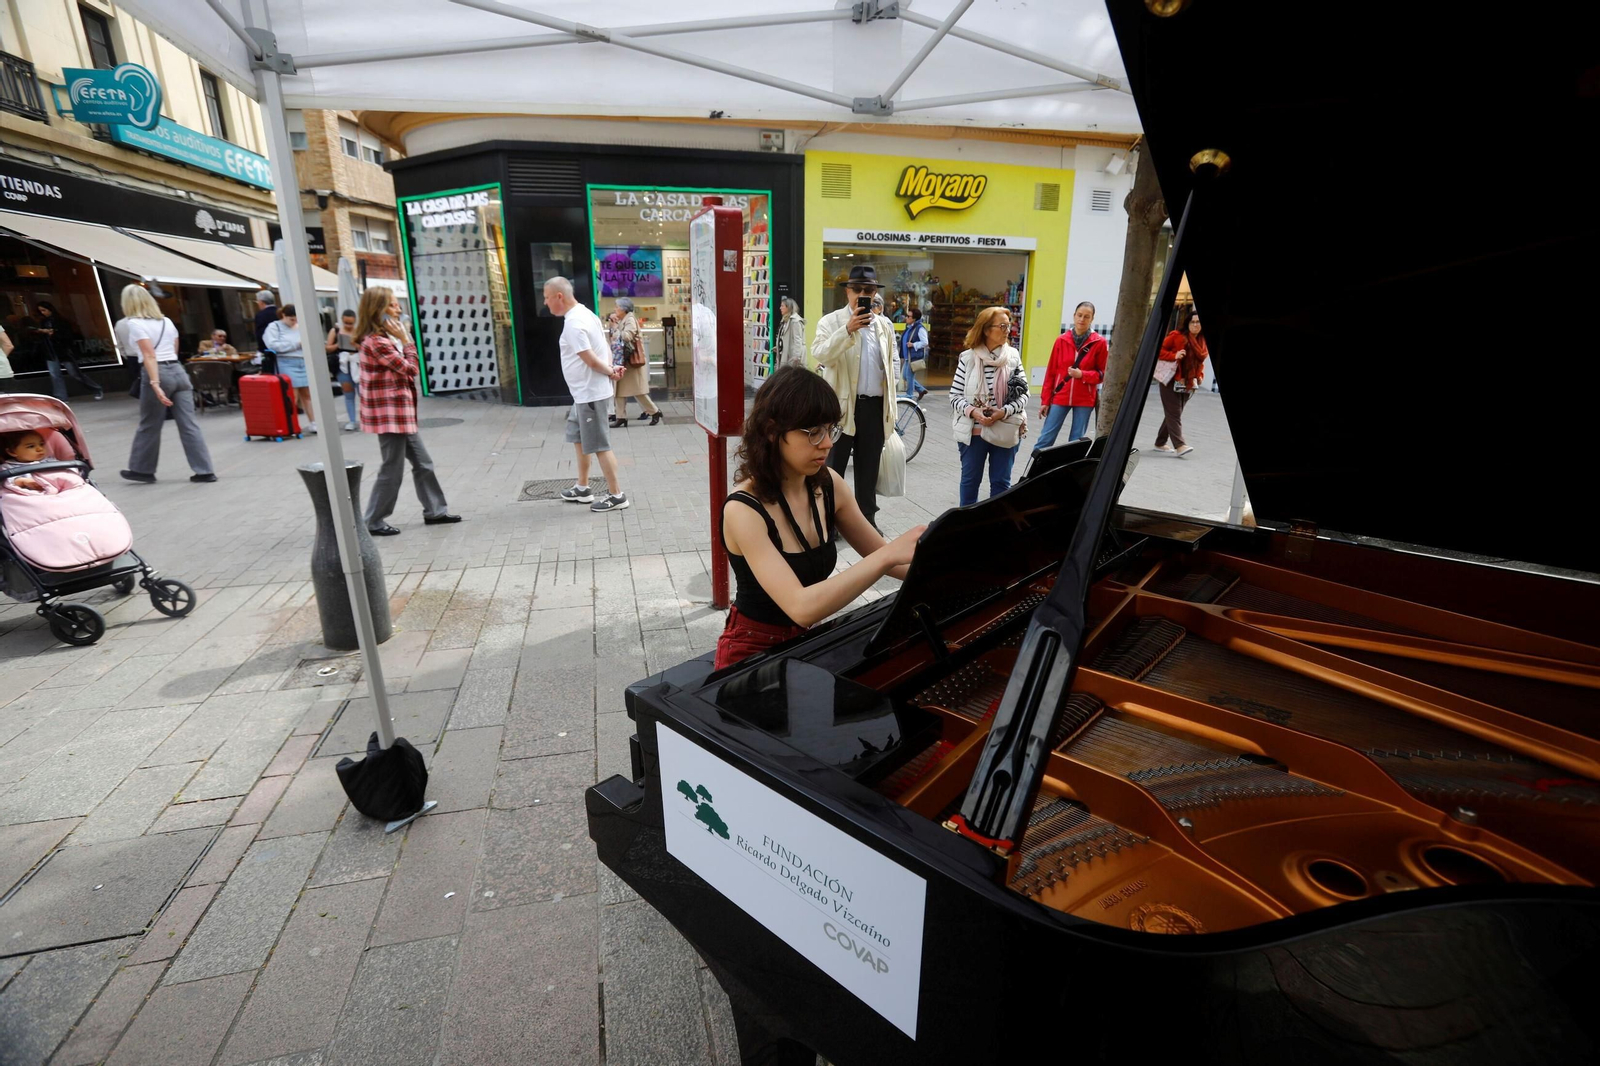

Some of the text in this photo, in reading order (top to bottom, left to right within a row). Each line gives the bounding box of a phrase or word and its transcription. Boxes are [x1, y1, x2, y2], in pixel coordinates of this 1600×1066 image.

[80, 87, 127, 101] EFETA
[173, 132, 222, 159] auditivos
[0, 174, 62, 199] TIENDAS
[897, 165, 988, 206] Moyano
[614, 192, 639, 206] LA
[645, 193, 689, 207] CASA
[405, 202, 422, 216] LA
[640, 207, 702, 222] CARCA
[857, 232, 1007, 246] GOLOSINAS APERITIVOS FIESTA
[600, 261, 656, 270] TE QUEDES
[605, 273, 618, 282] LA
[620, 273, 650, 282] TUYA!
[762, 834, 854, 903] FUNDACIÓN
[735, 834, 891, 948] Ricardo Delgado Vizcaíno
[822, 922, 889, 974] COVAP
